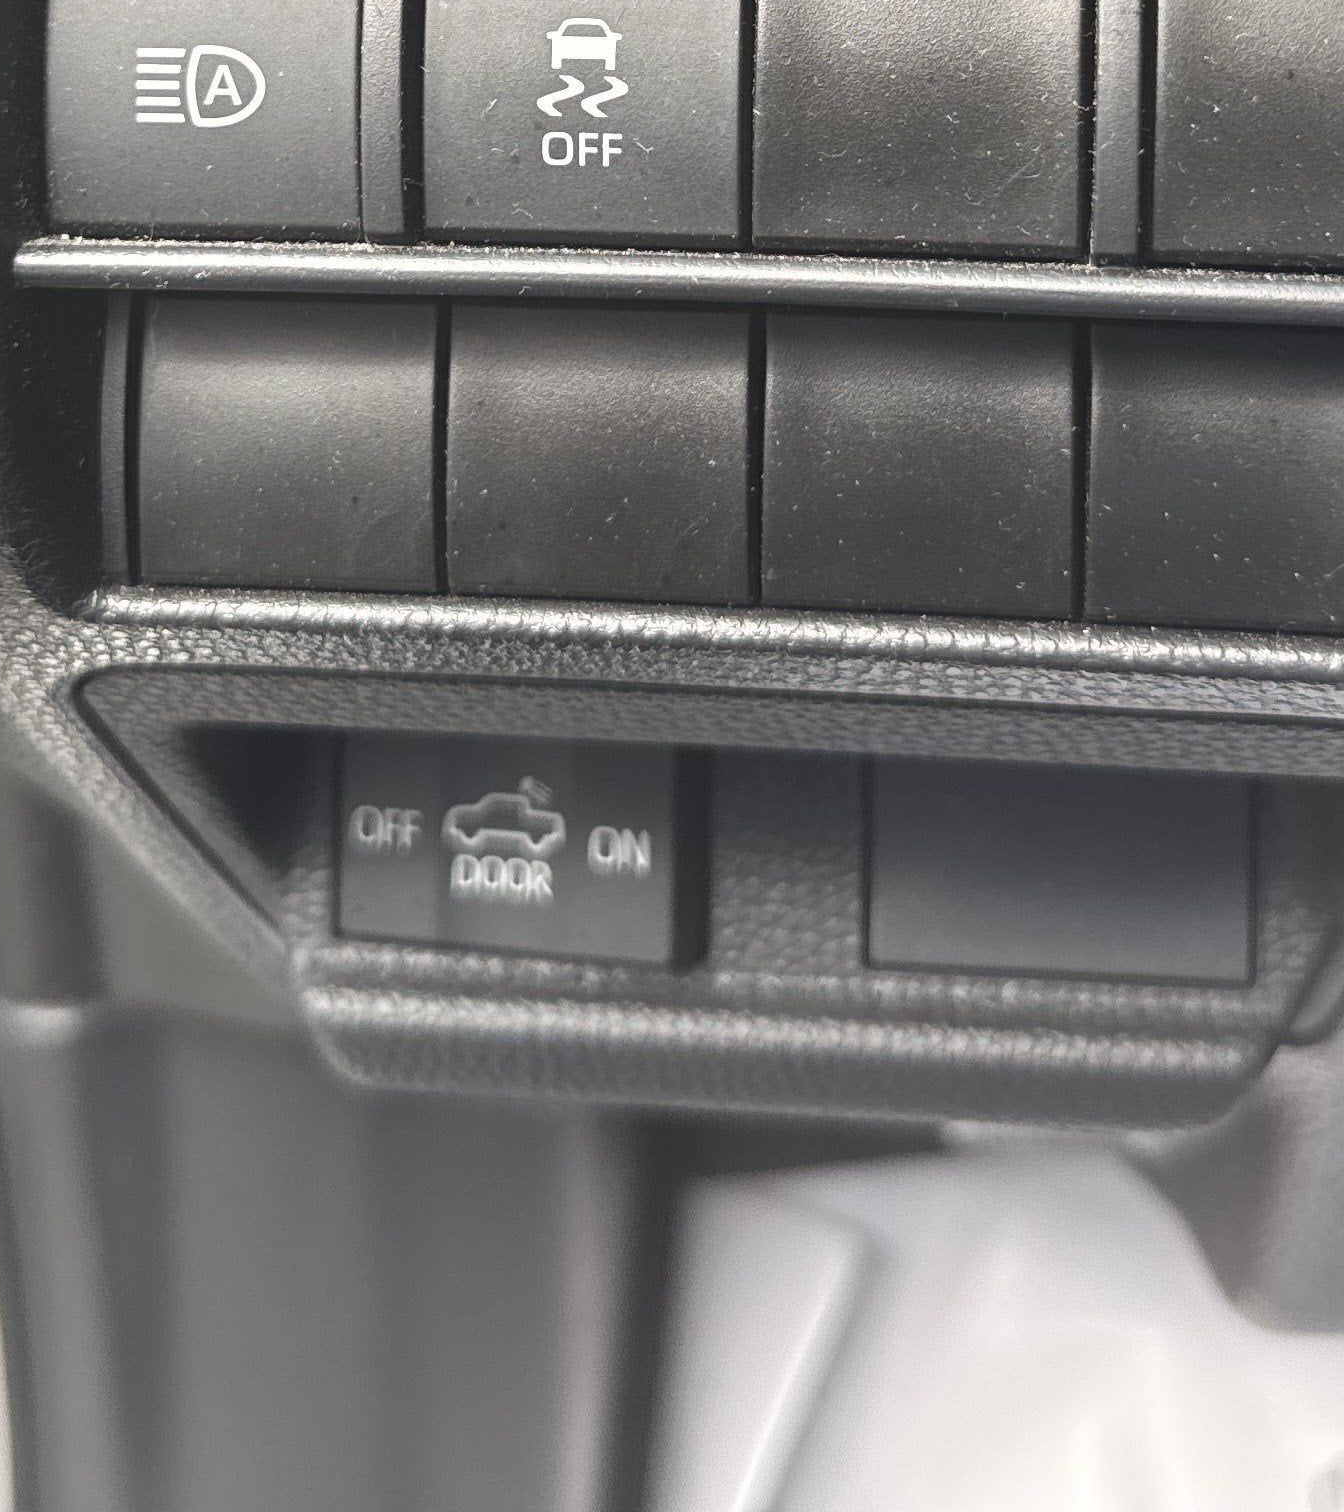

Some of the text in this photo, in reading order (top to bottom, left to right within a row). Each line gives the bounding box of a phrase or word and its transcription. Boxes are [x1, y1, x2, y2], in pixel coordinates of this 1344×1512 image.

[204, 65, 242, 106] A
[541, 131, 623, 167] OFF
[349, 805, 423, 849] OFF
[587, 825, 651, 874] ON
[451, 854, 554, 902] DOOR
